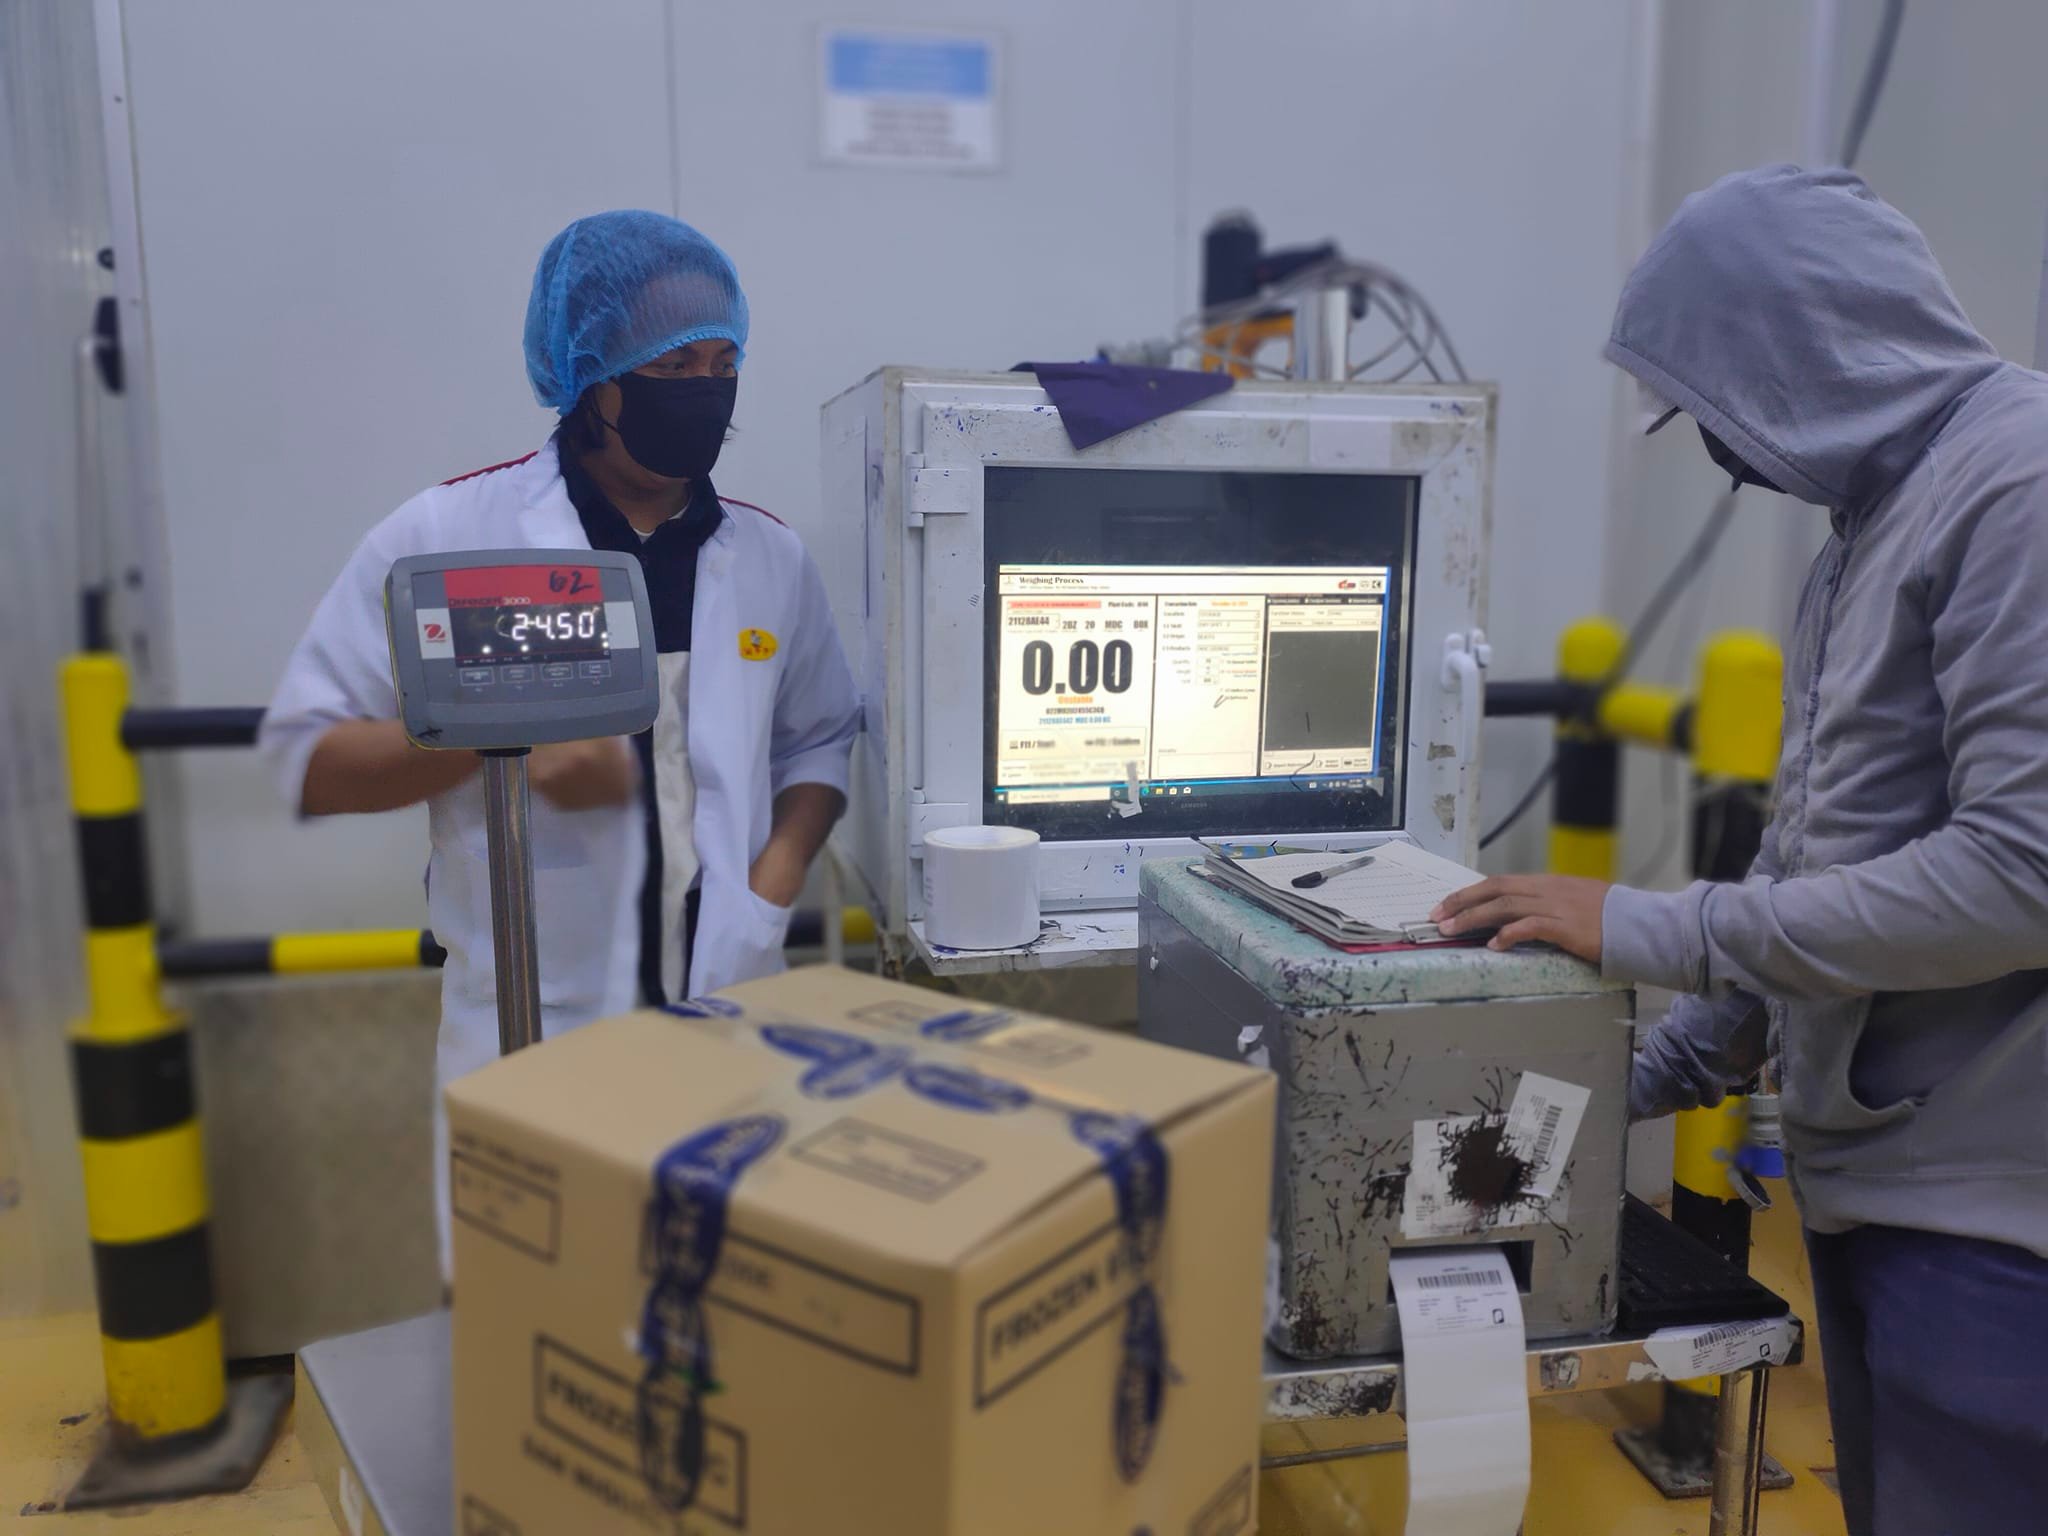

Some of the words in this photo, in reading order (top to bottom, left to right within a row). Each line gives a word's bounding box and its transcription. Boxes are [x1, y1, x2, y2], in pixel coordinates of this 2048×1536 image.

[1019, 576, 1053, 585] Weighing
[512, 612, 594, 641] 24.50
[1104, 620, 1123, 629] MDC
[1022, 639, 1133, 695] 0.00
